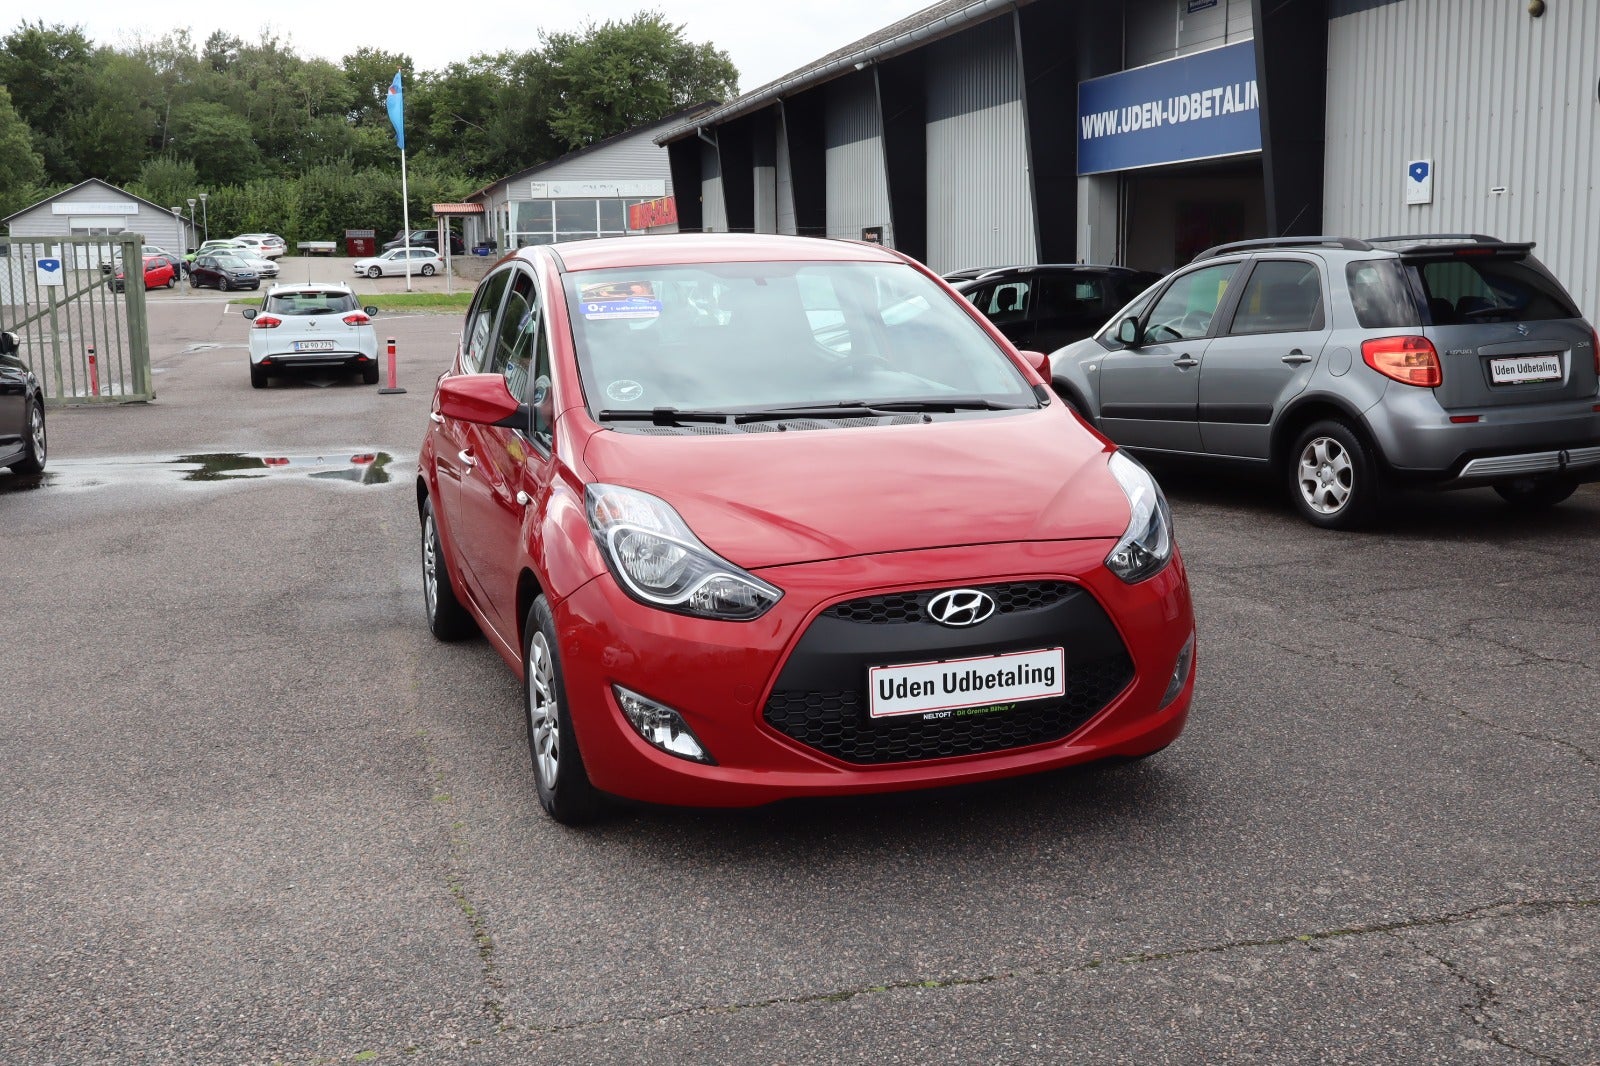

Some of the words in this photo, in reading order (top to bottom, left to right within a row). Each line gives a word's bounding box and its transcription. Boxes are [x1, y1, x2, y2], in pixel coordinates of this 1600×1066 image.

[1081, 80, 1259, 140] WWW.UDEN-UDBETALIN
[1494, 365, 1516, 376] Uden
[1518, 361, 1558, 374] Udbetaling
[879, 676, 935, 701] Uden
[942, 663, 1056, 695] Udbetaling
[923, 711, 952, 720] NELTOFT
[956, 709, 966, 717] Dit
